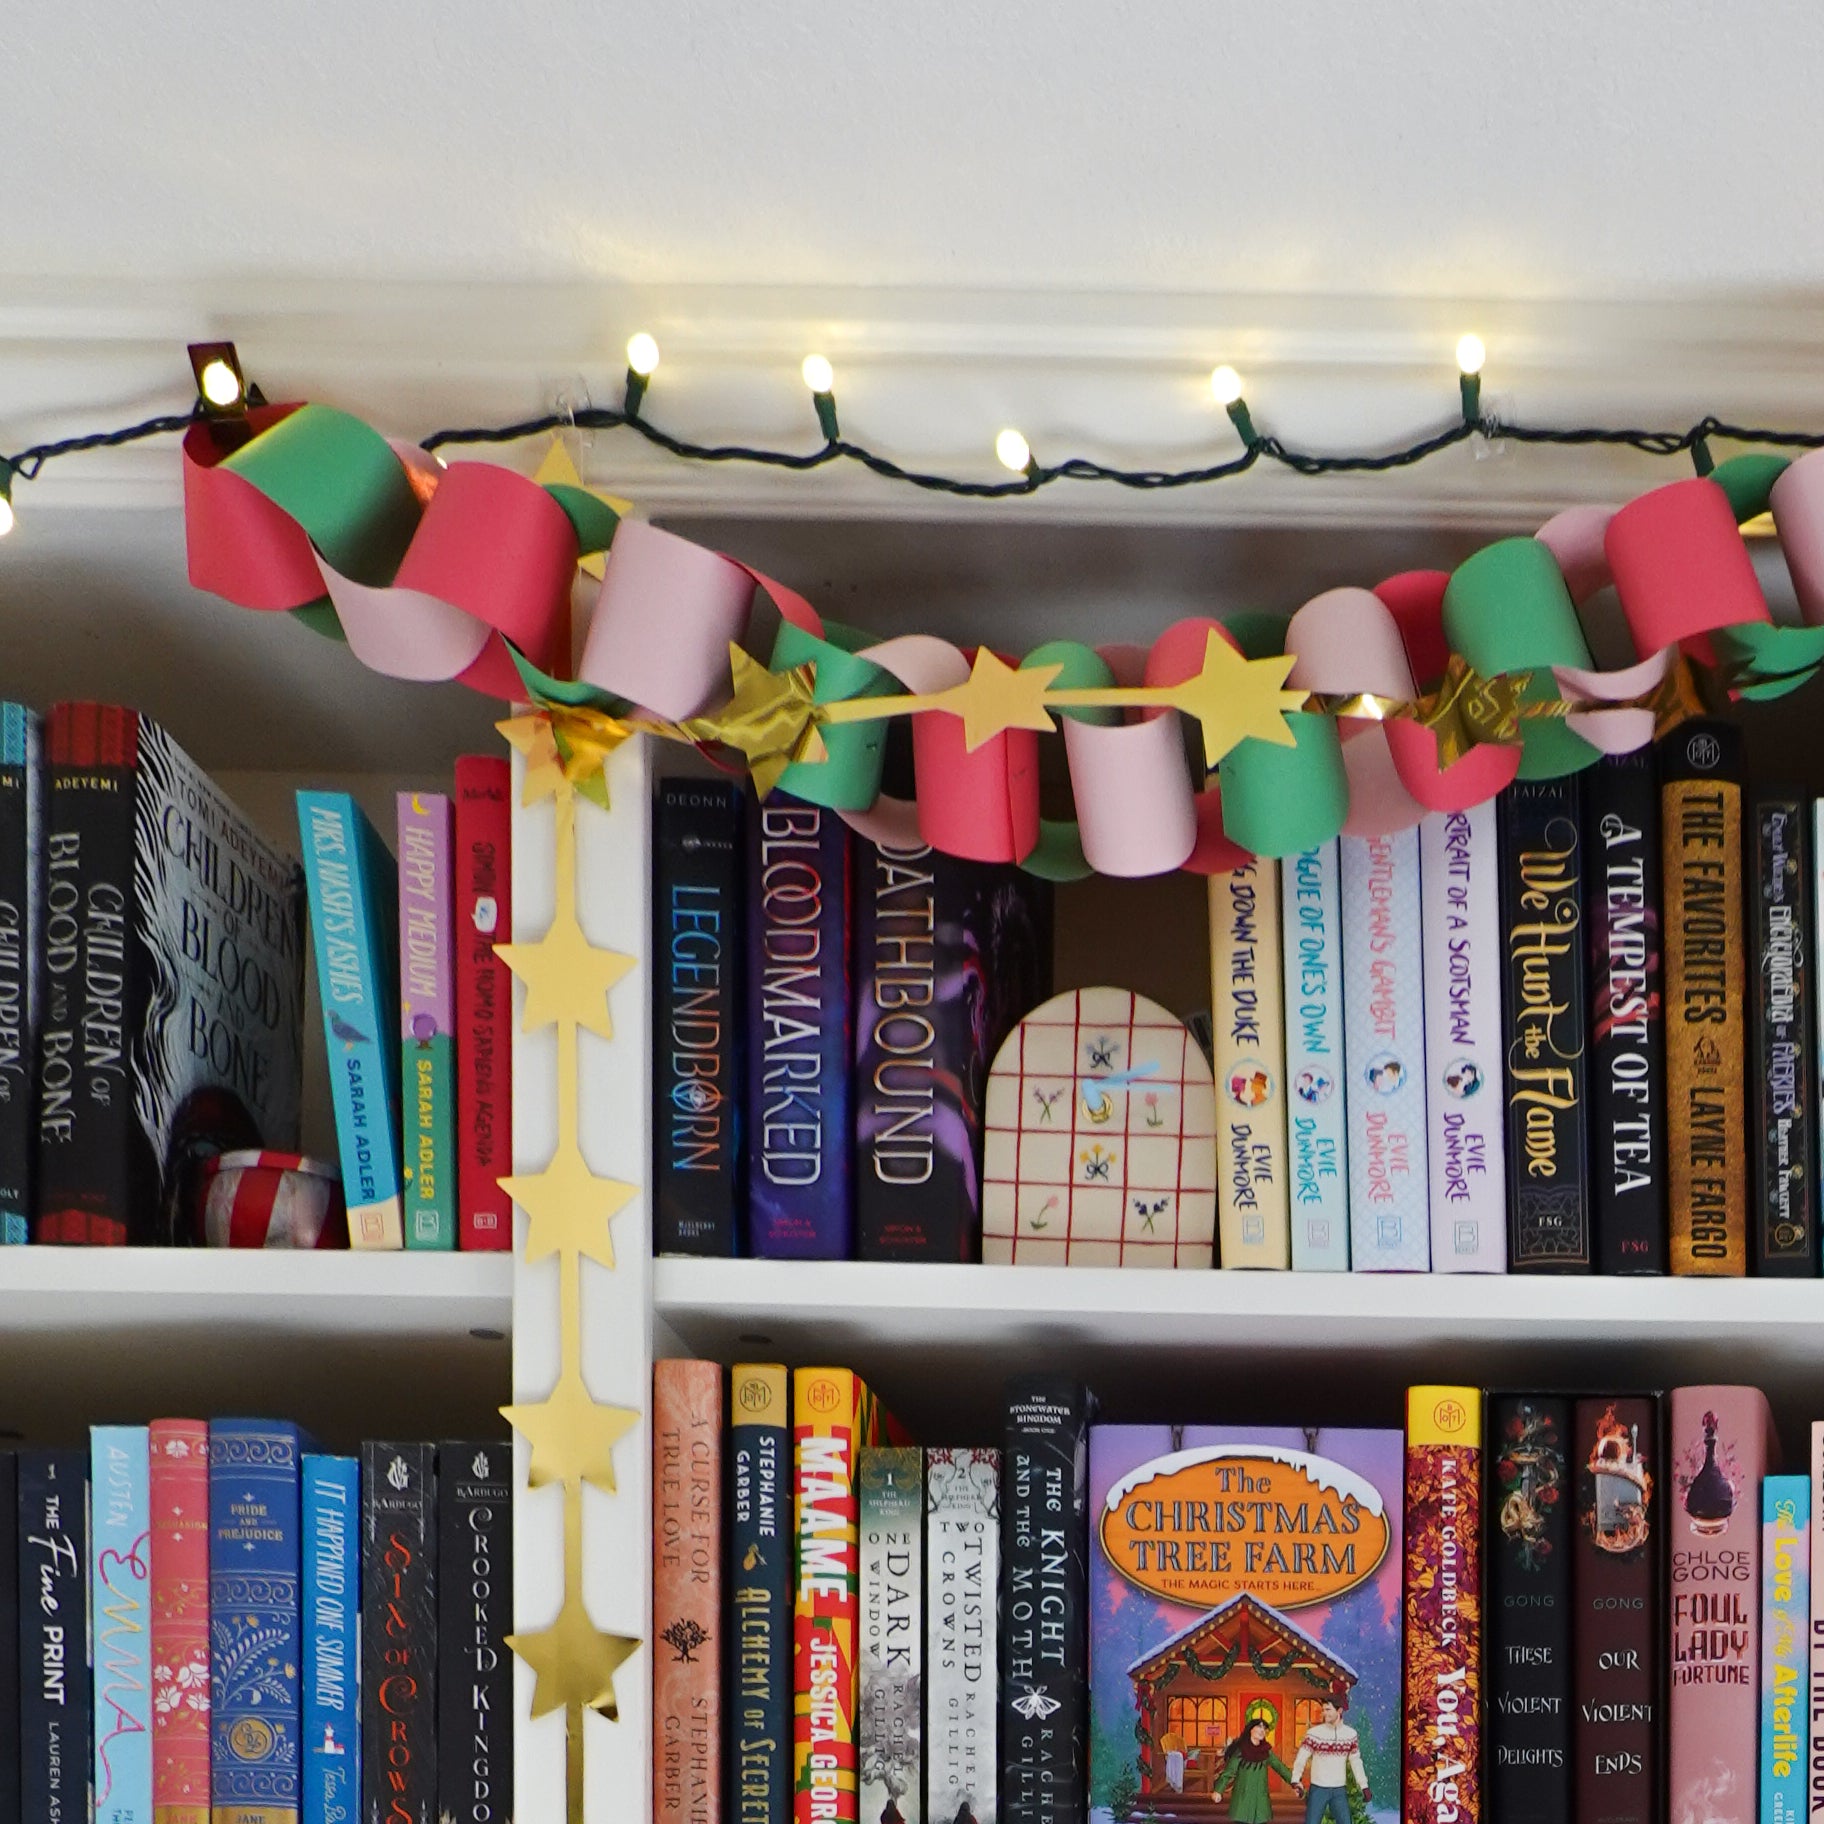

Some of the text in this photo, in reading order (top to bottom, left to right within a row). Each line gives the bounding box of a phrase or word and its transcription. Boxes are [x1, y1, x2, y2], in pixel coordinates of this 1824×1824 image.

[55, 777, 119, 792] ADEYEMI
[405, 827, 436, 998] HAPPY MEDIUM
[1682, 791, 1727, 1024] THE FAVORITES
[671, 886, 721, 1171] LEGENDBORN
[761, 808, 821, 1186] BLOODMARKED
[1600, 813, 1652, 1196] A TEMPEST OF TEA
[347, 1058, 376, 1201] SARAH ADLER
[1689, 1088, 1728, 1259] LAYNE FARGO
[231, 1504, 267, 1516] PRIDE
[1215, 1467, 1271, 1494] The
[218, 1528, 283, 1541] PREJUDICE
[799, 1436, 847, 1603] MAAME
[1126, 1502, 1360, 1535] CHRISTMAS
[1129, 1540, 1356, 1575] TREE FARM
[1161, 1579, 1185, 1590] THE
[1188, 1579, 1230, 1590] MAGIC
[1233, 1580, 1278, 1591] STARTS
[28, 1497, 77, 1704] THE Fine PRINT
[315, 1480, 346, 1712] IT HAPPENED ONE SUMMER
[809, 1636, 838, 1742] JESSICA
[1598, 1650, 1641, 1669] OUR
[1436, 1667, 1466, 1743] You,
[1582, 1703, 1652, 1722] VIOLENT
[47, 1721, 61, 1789] LAUREN
[1595, 1754, 1642, 1775] ENDS
[235, 1815, 266, 1824] JANE
